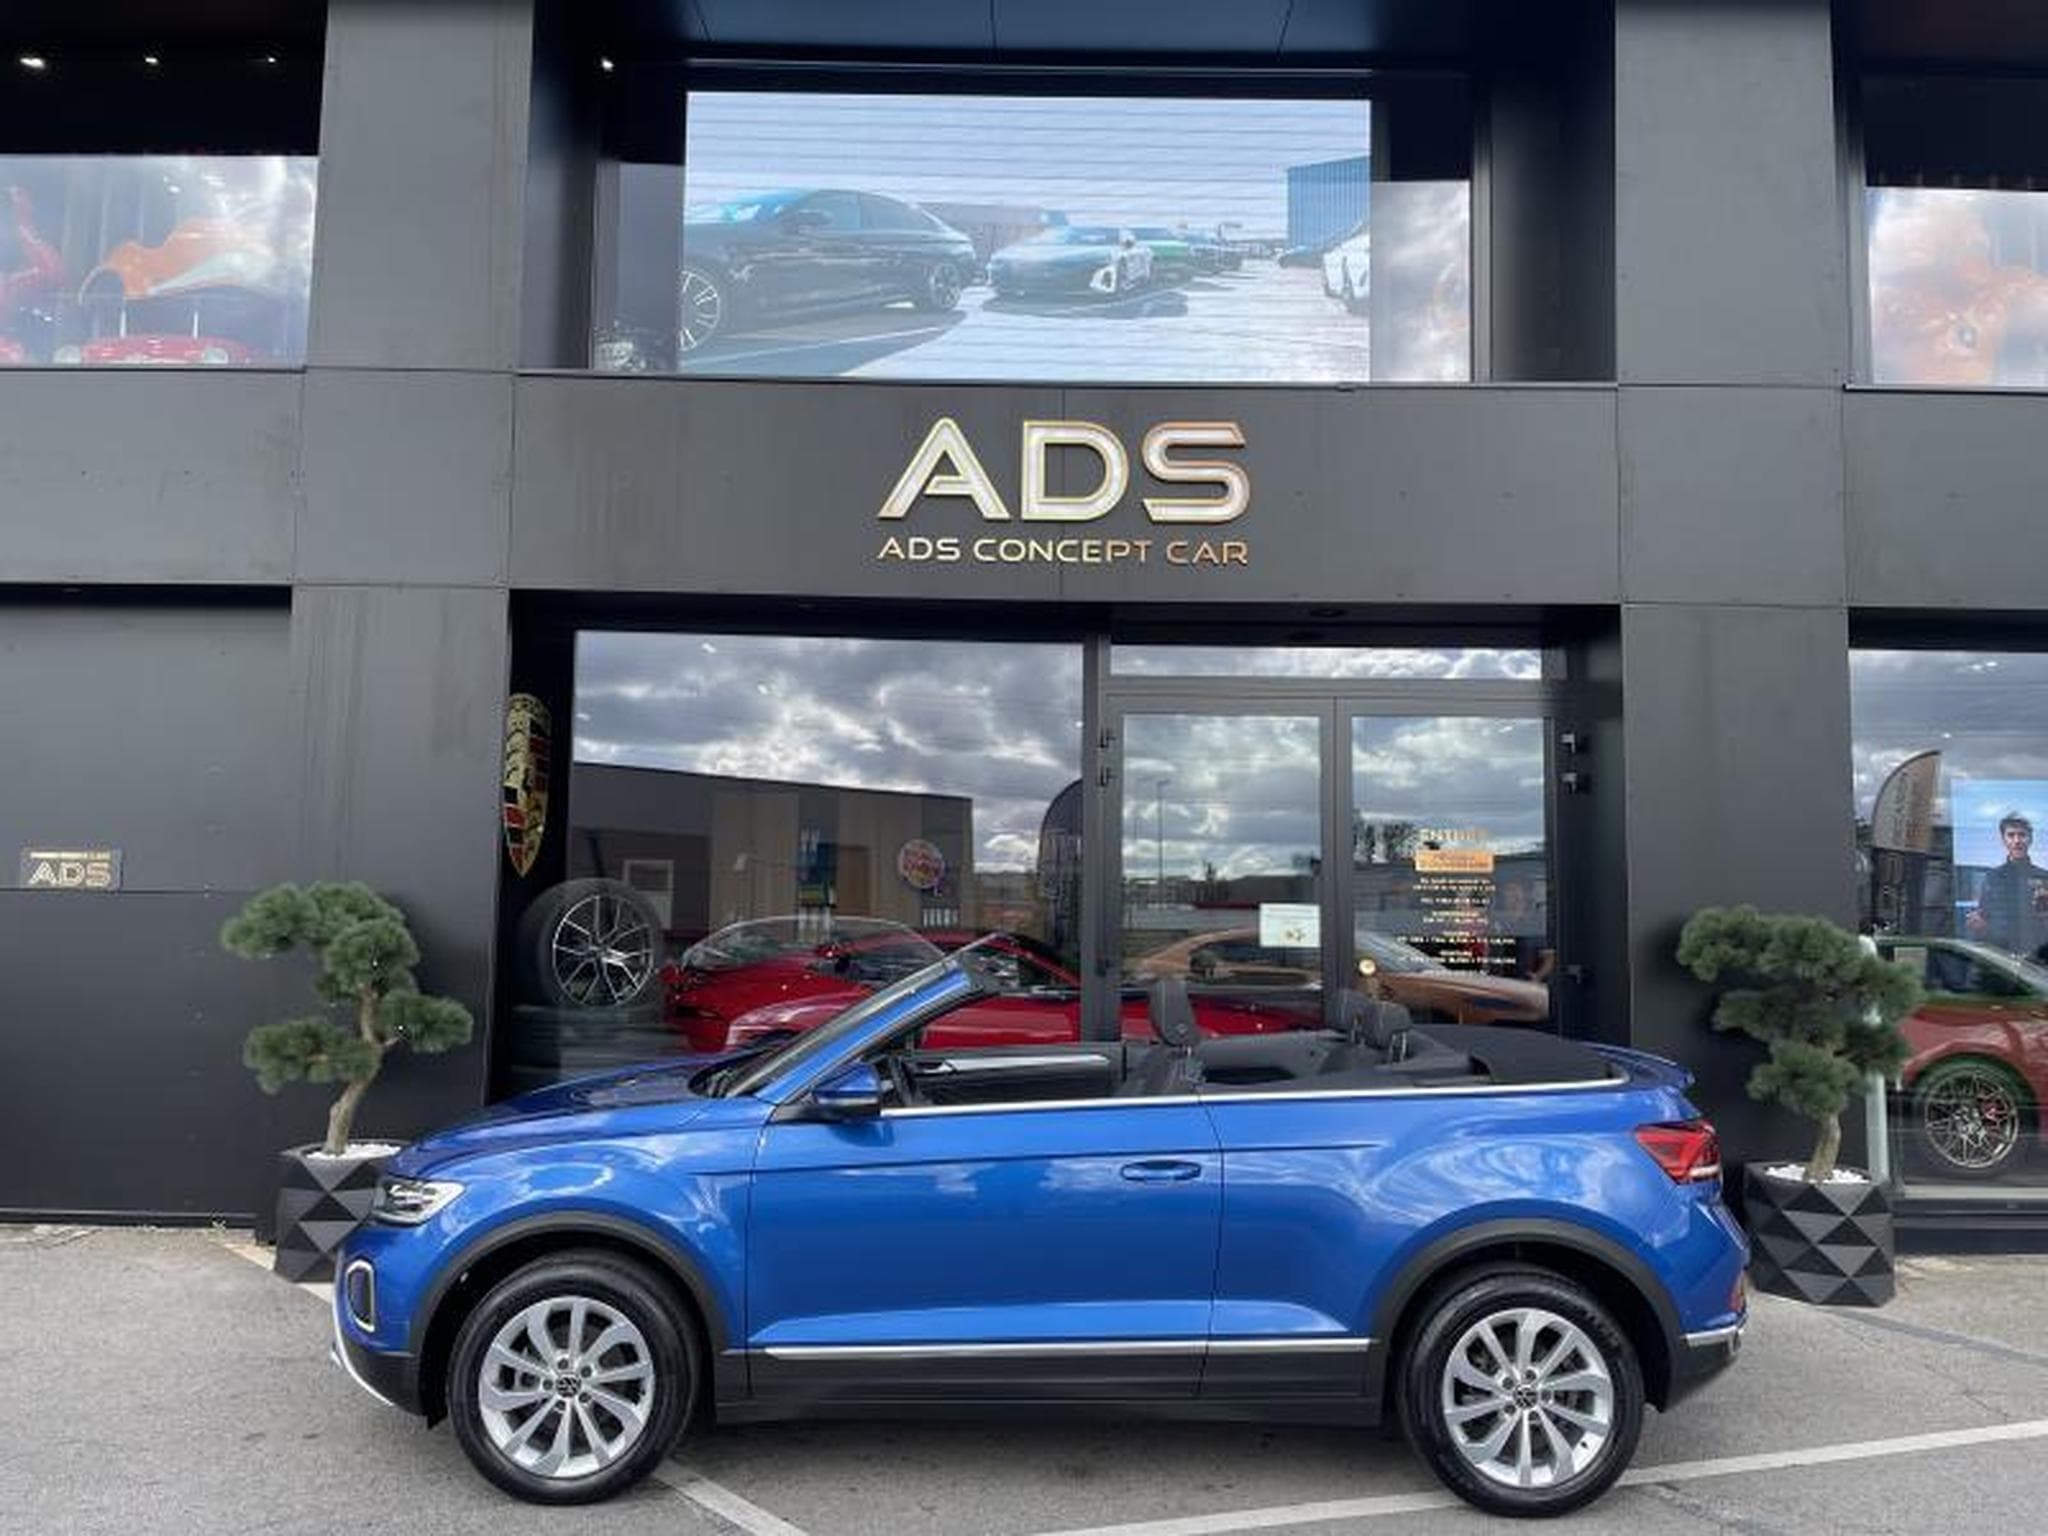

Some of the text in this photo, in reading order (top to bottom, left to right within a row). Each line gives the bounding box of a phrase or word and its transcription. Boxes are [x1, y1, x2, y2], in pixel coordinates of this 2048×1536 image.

[877, 416, 1251, 523] ADS
[877, 536, 1250, 567] ADS CONCEPT CAR
[28, 861, 112, 887] ADS
